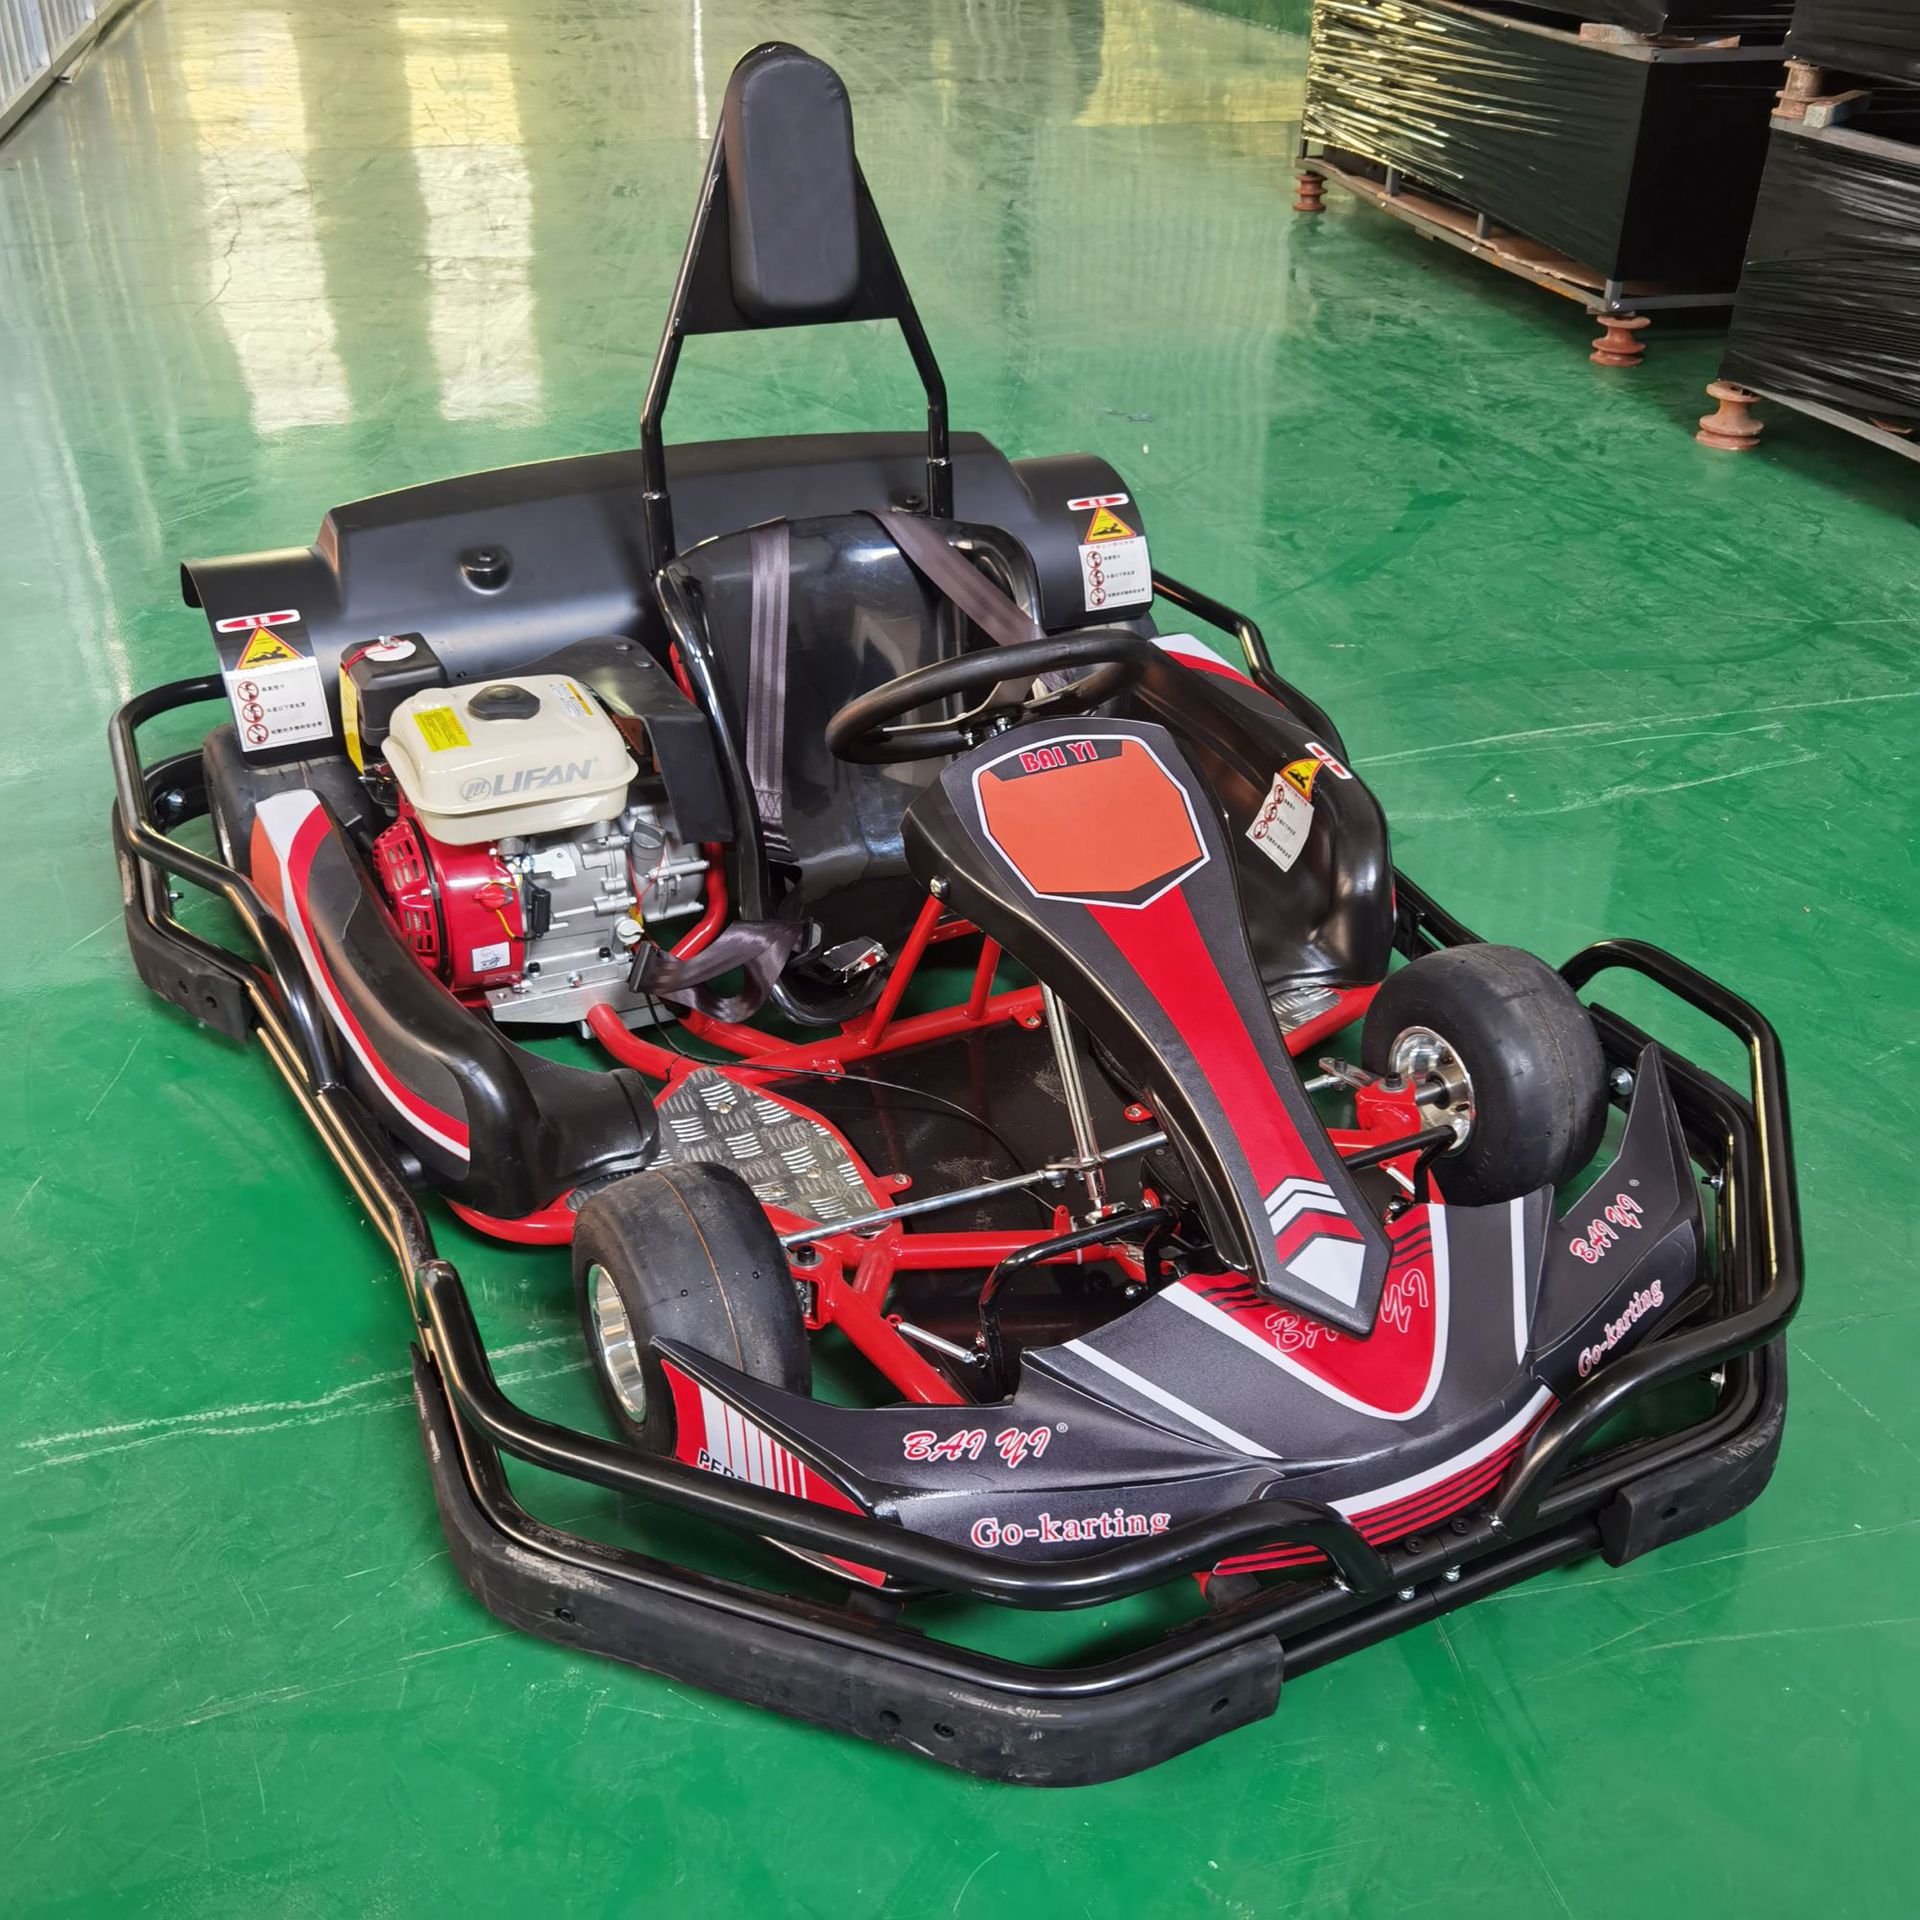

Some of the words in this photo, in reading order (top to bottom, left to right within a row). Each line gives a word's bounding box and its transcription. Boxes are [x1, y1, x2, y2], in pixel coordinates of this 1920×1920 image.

[1018, 745, 1067, 773] BAI
[1067, 740, 1098, 762] YI
[492, 759, 592, 797] LIFAN
[1569, 1218, 1620, 1264] BAI
[1605, 1193, 1644, 1229] YI
[1577, 1279, 1665, 1377] Go-karting
[903, 1429, 987, 1462] BAI
[994, 1426, 1051, 1468] YI
[970, 1508, 1171, 1548] Go-karting
